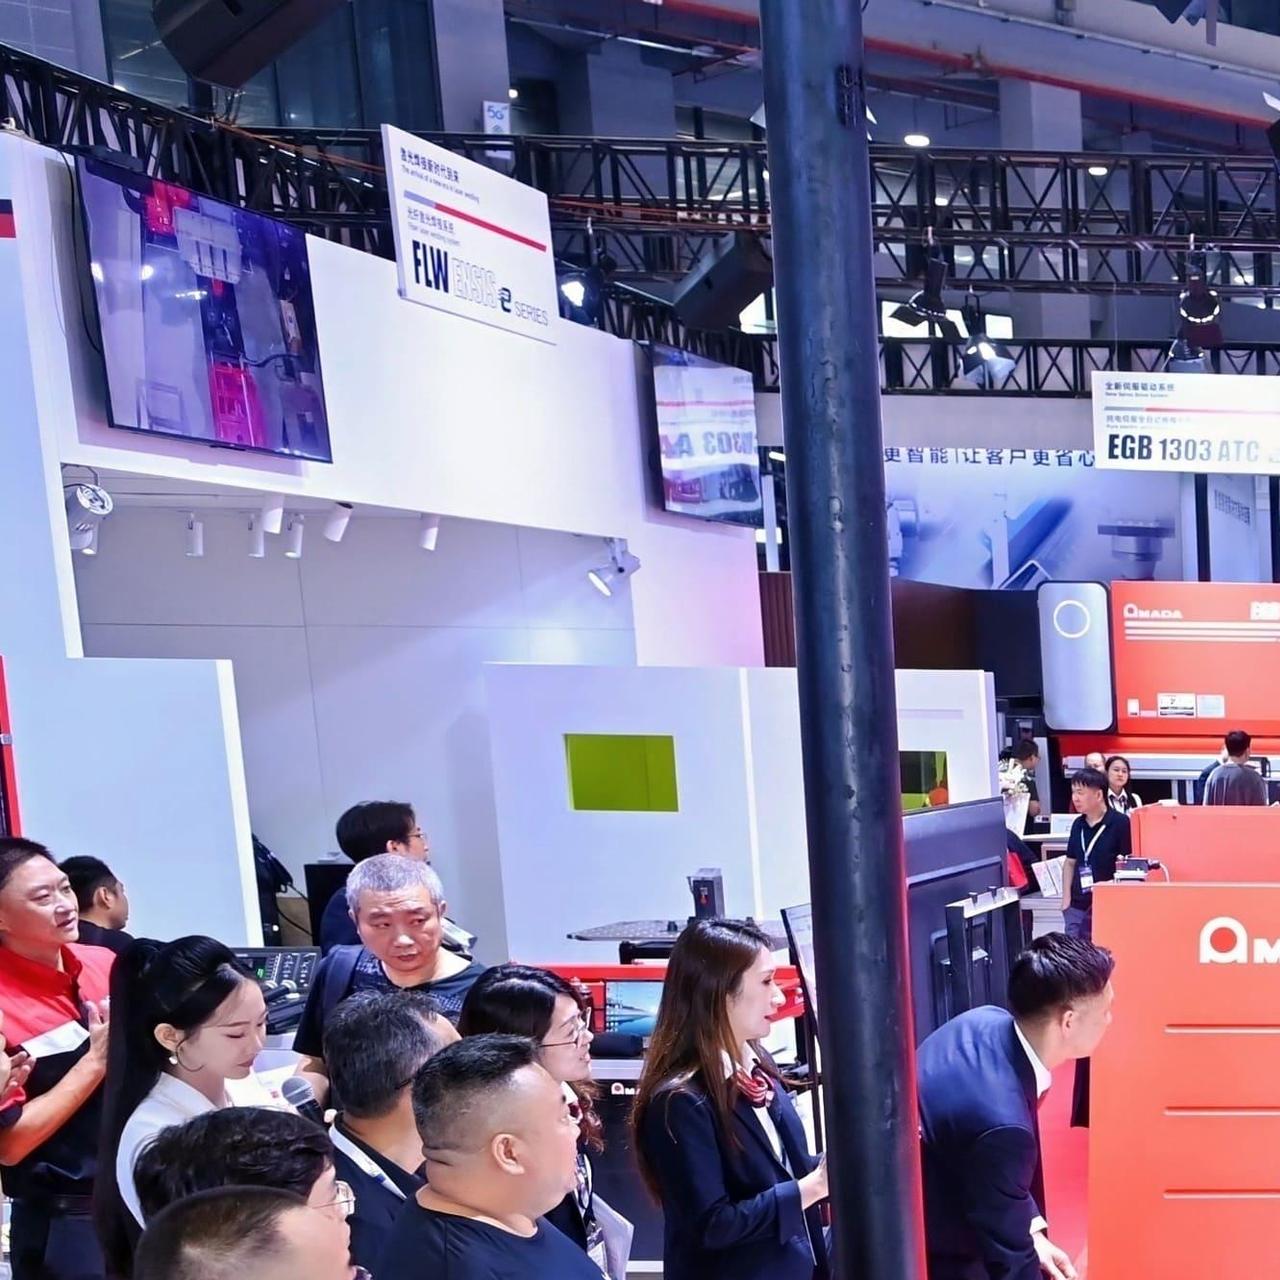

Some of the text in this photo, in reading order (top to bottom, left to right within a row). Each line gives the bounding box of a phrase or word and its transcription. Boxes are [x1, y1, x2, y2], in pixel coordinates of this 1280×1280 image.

[487, 105, 504, 120] 5G
[412, 239, 449, 294] FLW
[514, 301, 549, 327] SERIES
[1108, 434, 1152, 460] EGB
[1159, 438, 1212, 462] 1303
[1218, 439, 1260, 463] ATC
